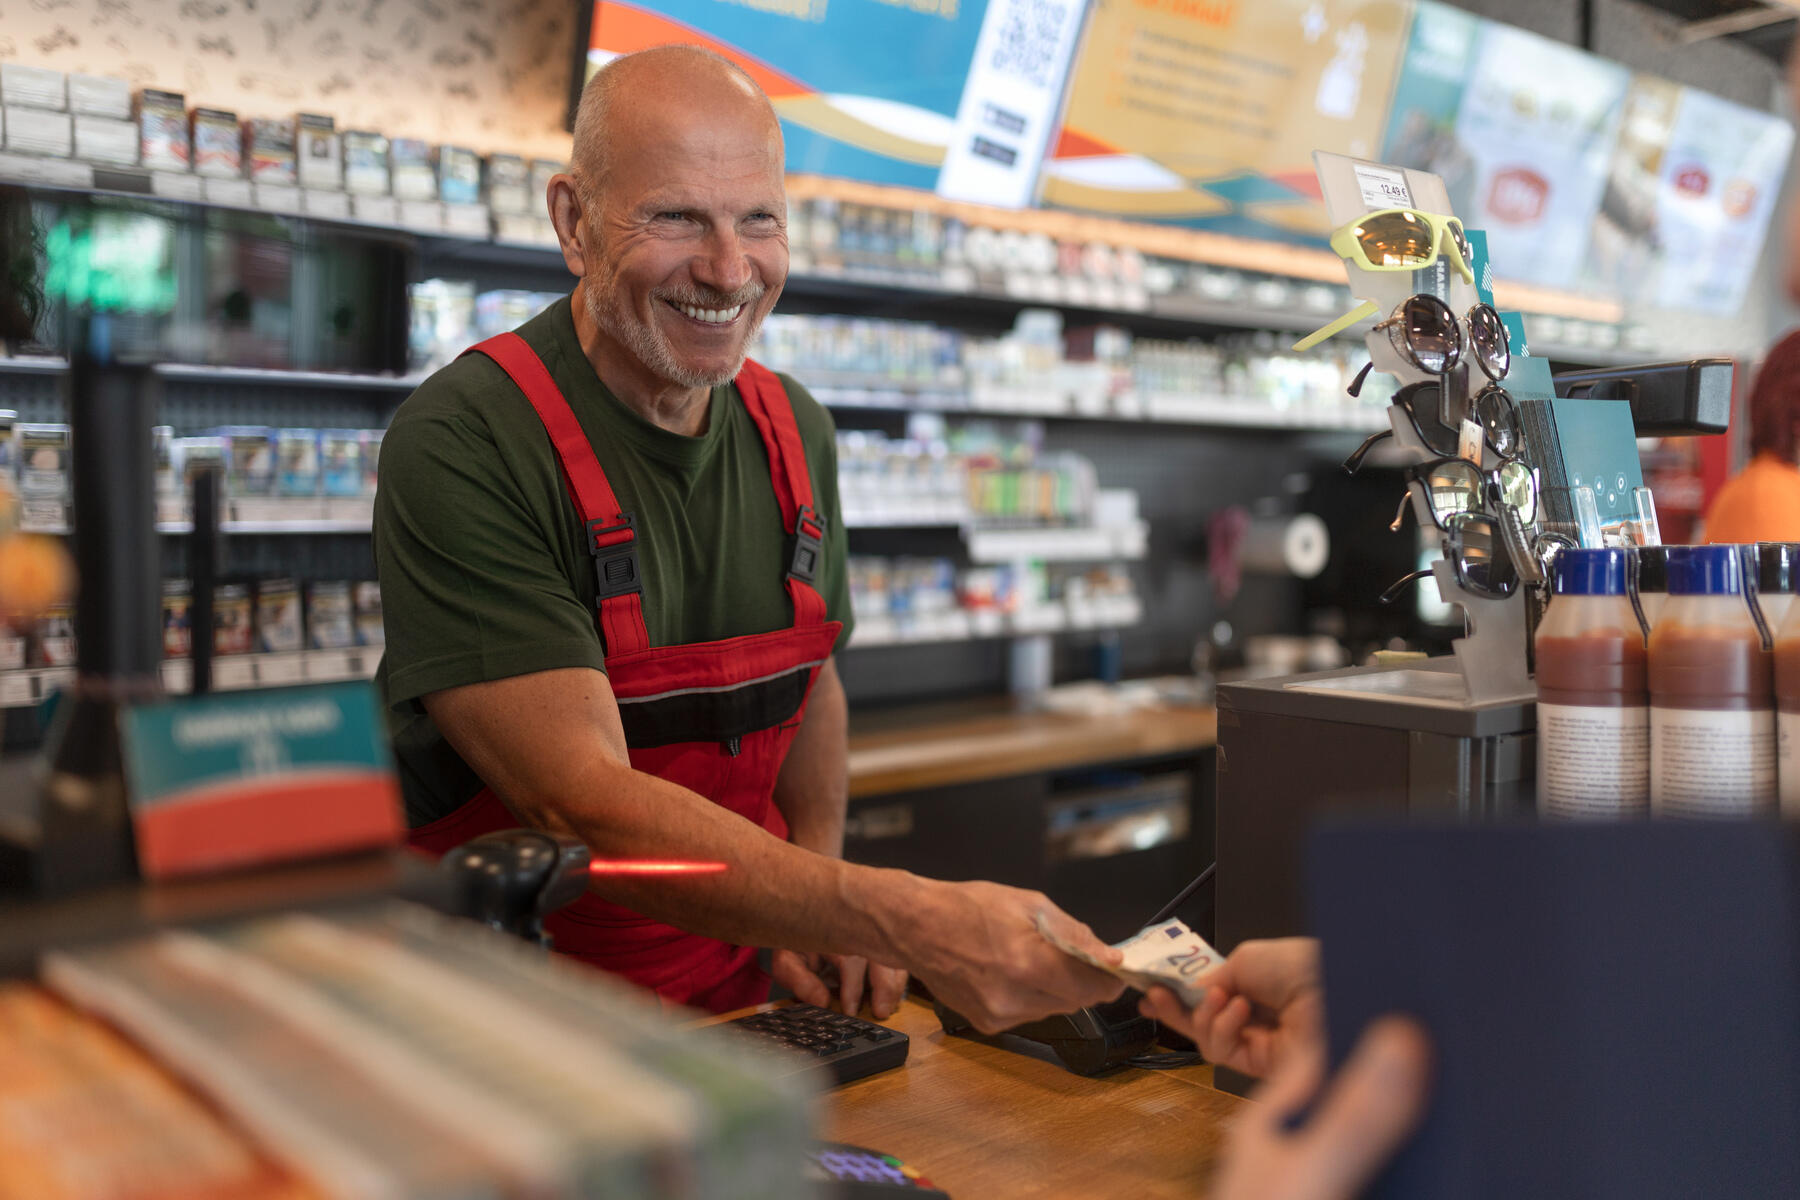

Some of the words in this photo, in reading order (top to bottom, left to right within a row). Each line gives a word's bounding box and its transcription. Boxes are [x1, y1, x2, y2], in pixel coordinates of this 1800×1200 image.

[1380, 183, 1401, 196] 12.49
[1401, 187, 1408, 198] €
[1166, 945, 1211, 977] 20
